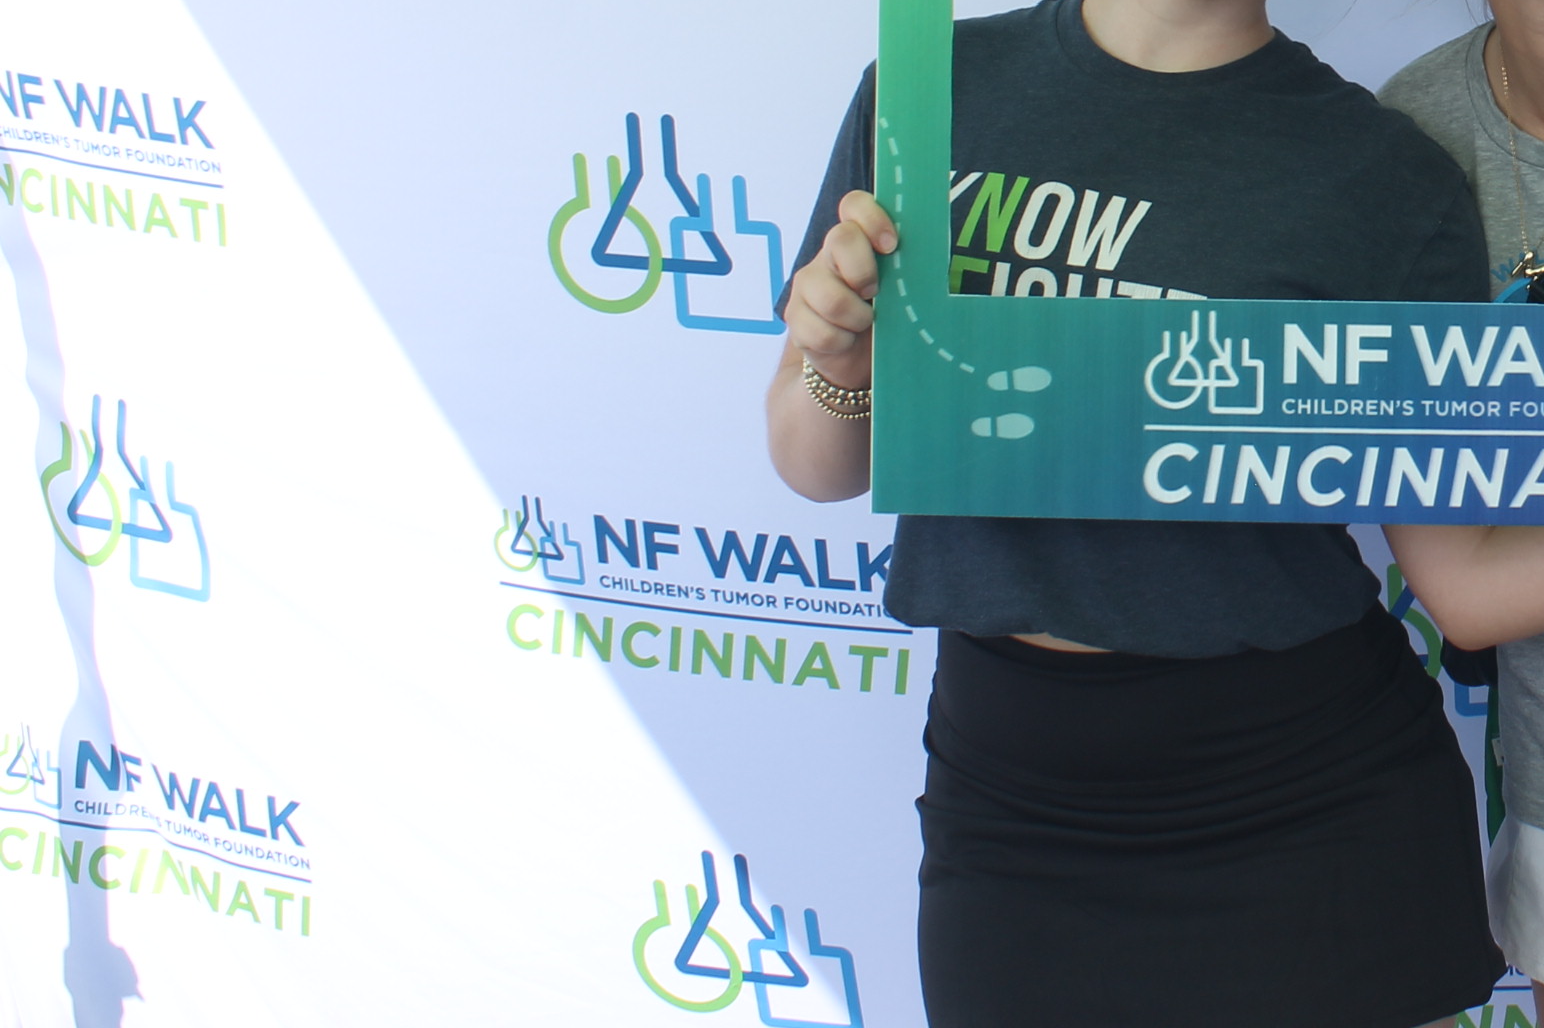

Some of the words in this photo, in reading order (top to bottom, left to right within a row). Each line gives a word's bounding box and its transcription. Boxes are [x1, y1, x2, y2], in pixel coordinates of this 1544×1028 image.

[53, 78, 216, 150] WALK
[0, 125, 71, 149] HILDREN'S
[74, 139, 121, 158] TUMOR
[125, 148, 222, 174] FOUNDATION
[1283, 323, 1392, 385] NF
[1281, 398, 1414, 417] CHILDREN'S
[1422, 399, 1500, 418] TUMOR
[593, 514, 681, 571] NF
[694, 526, 894, 592] WALK
[599, 574, 706, 601] CHILDREN'S
[710, 588, 778, 609] TUMOR
[506, 603, 910, 696] CINCINNATI
[75, 739, 142, 792] NF
[151, 762, 306, 848] WALK
[164, 819, 211, 845] TUMOR
[213, 837, 311, 870] FOUNDATION
[0, 826, 311, 938] CINCINNATI
